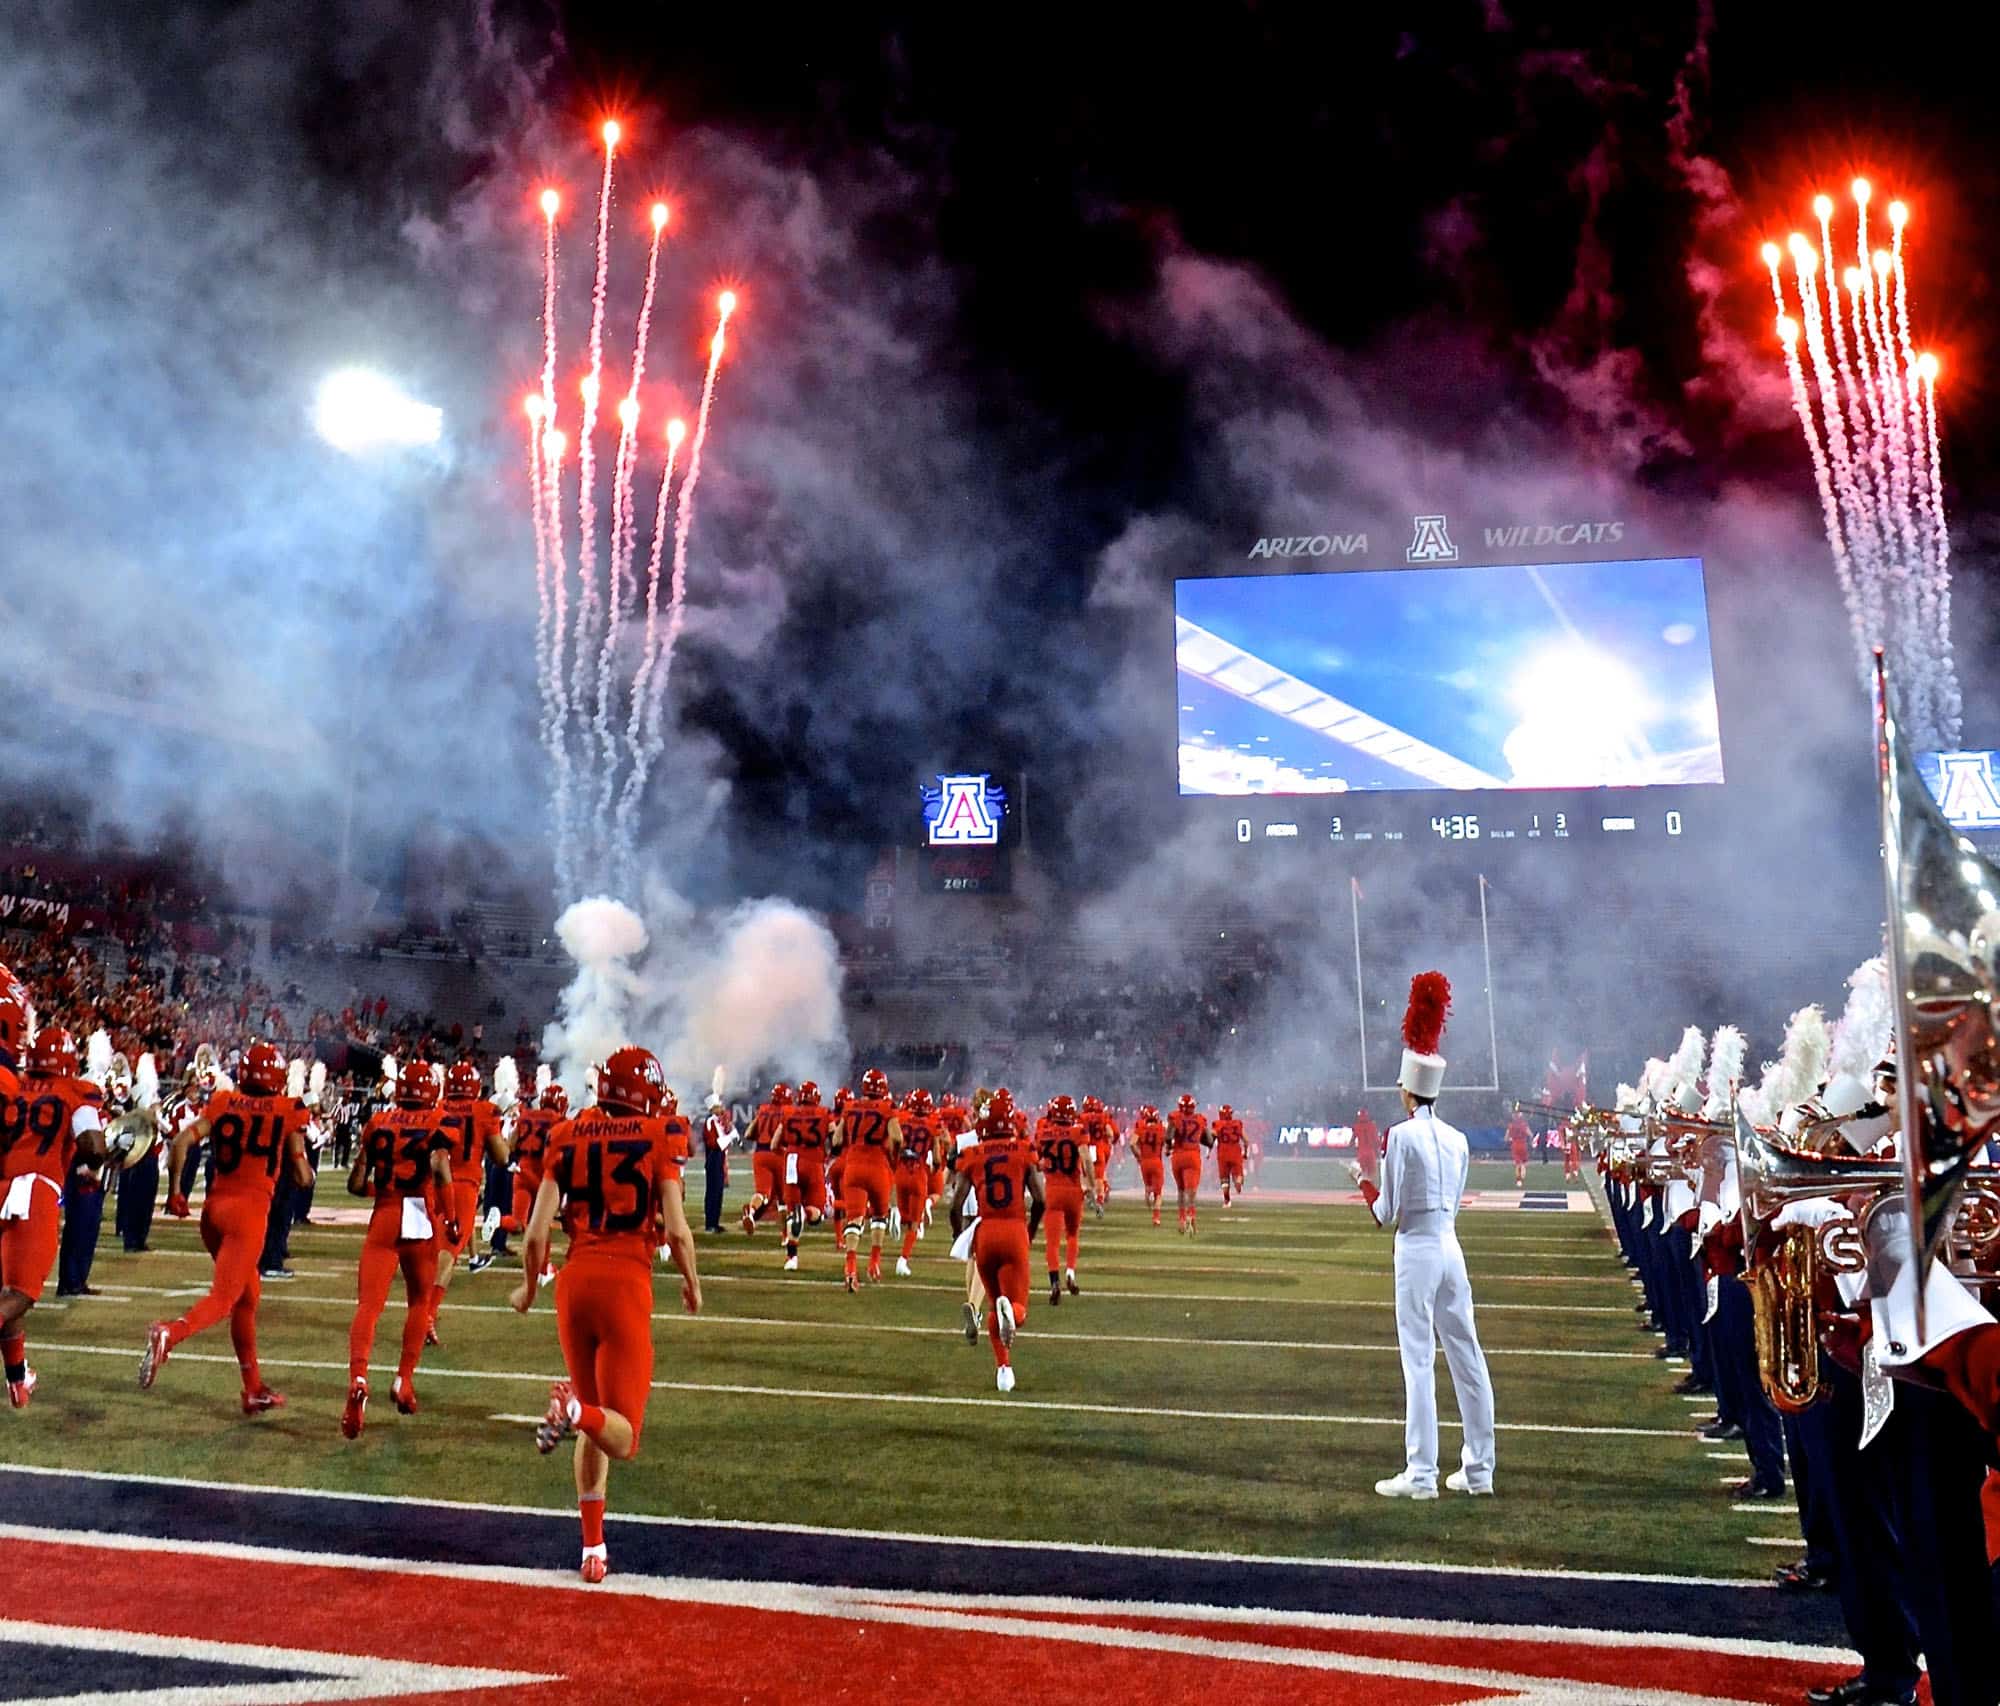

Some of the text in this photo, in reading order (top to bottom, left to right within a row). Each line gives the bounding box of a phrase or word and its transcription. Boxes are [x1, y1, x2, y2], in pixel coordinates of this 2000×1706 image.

[1248, 515, 1625, 563] ARIZONA A WILDCATS
[929, 777, 998, 844] A
[1332, 817, 1342, 832] 3
[1431, 815, 1480, 840] 4:36
[1556, 813, 1566, 828] 3
[1666, 811, 1682, 835] 0
[1237, 819, 1251, 842] 0
[944, 877, 979, 889] zero
[214, 1113, 285, 1176] 84
[517, 1119, 551, 1158] 23
[787, 1118, 821, 1147] 53
[848, 1111, 882, 1145] 72
[367, 1129, 430, 1190] 83
[1040, 1139, 1078, 1175] 30
[557, 1140, 653, 1231] 43
[984, 1155, 1012, 1208] 6
